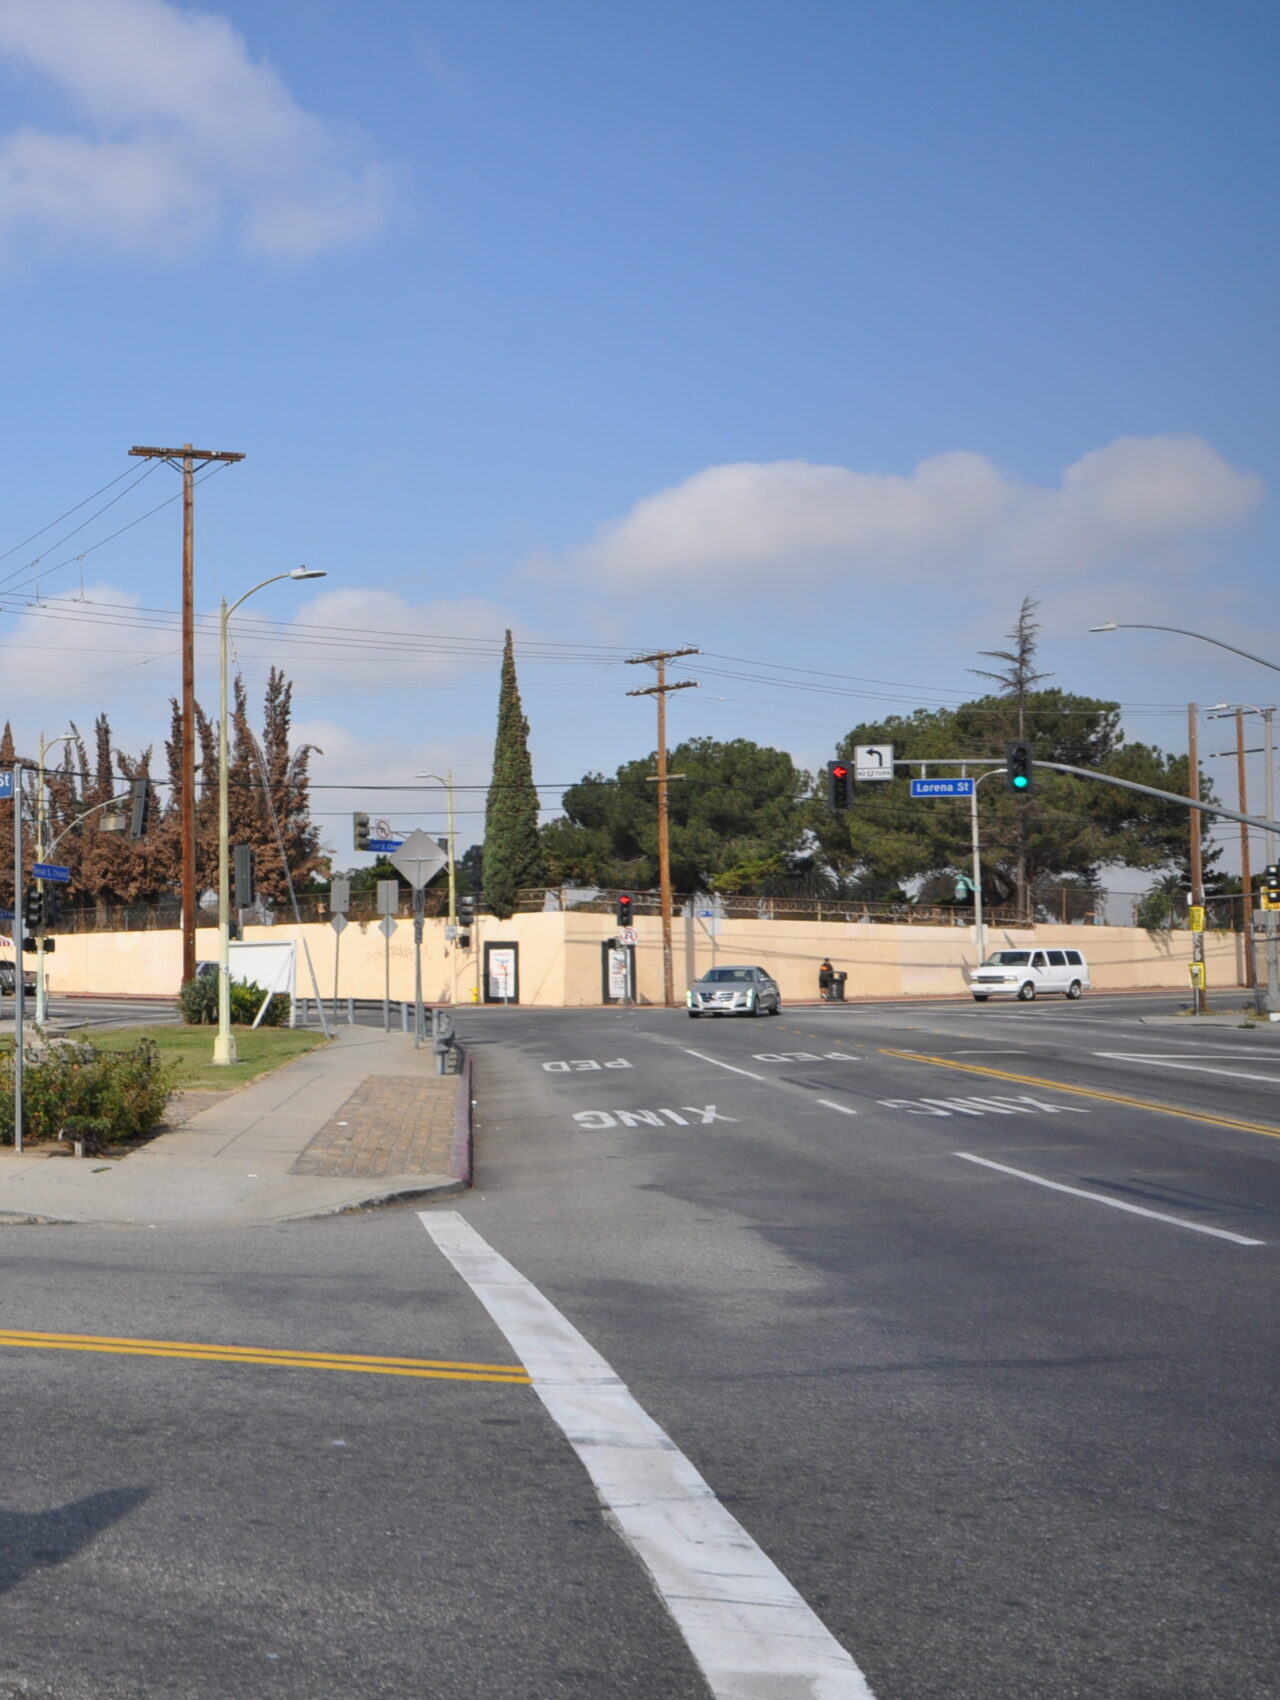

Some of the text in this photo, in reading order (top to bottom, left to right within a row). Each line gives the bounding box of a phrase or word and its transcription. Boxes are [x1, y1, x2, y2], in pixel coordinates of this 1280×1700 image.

[916, 782, 969, 793] Lorena St
[752, 1051, 860, 1064] PED
[542, 1057, 633, 1073] PED
[572, 1104, 740, 1129] XING
